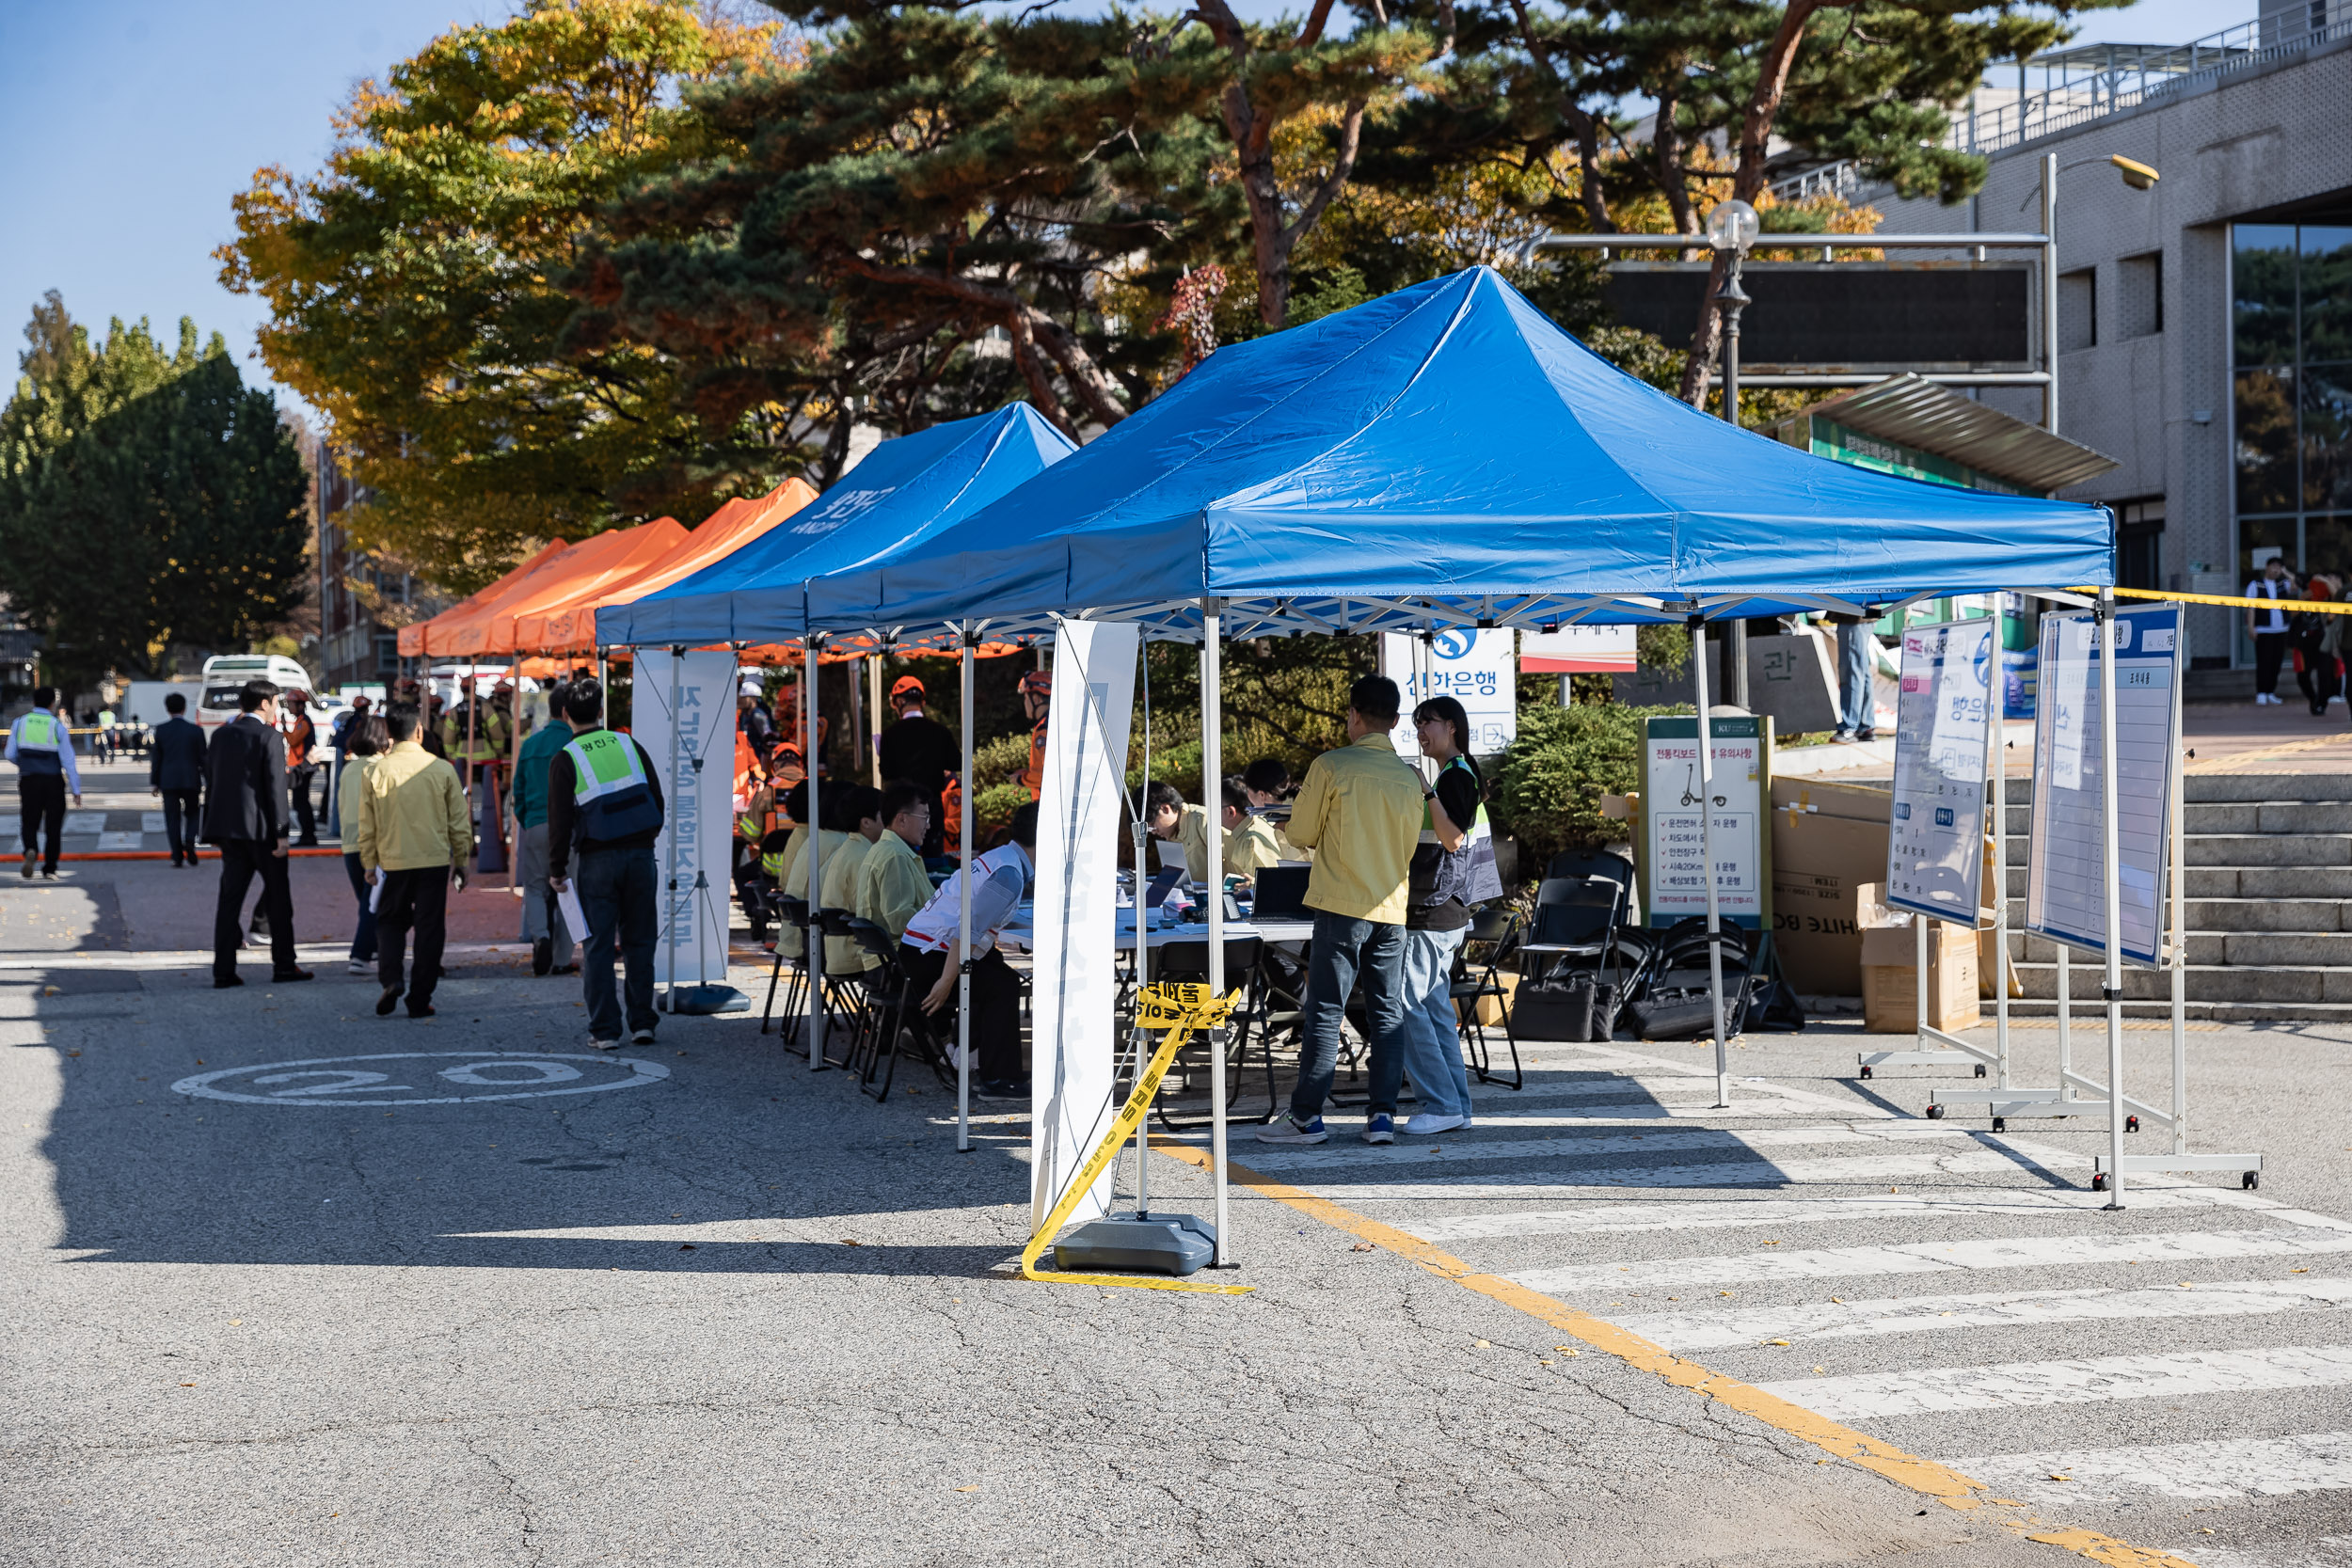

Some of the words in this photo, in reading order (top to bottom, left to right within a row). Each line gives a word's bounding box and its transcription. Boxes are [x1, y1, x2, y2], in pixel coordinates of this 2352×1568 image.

[580, 736, 618, 752] 광진구
[1806, 915, 1857, 935] HITE
[252, 1060, 584, 1098] 20
